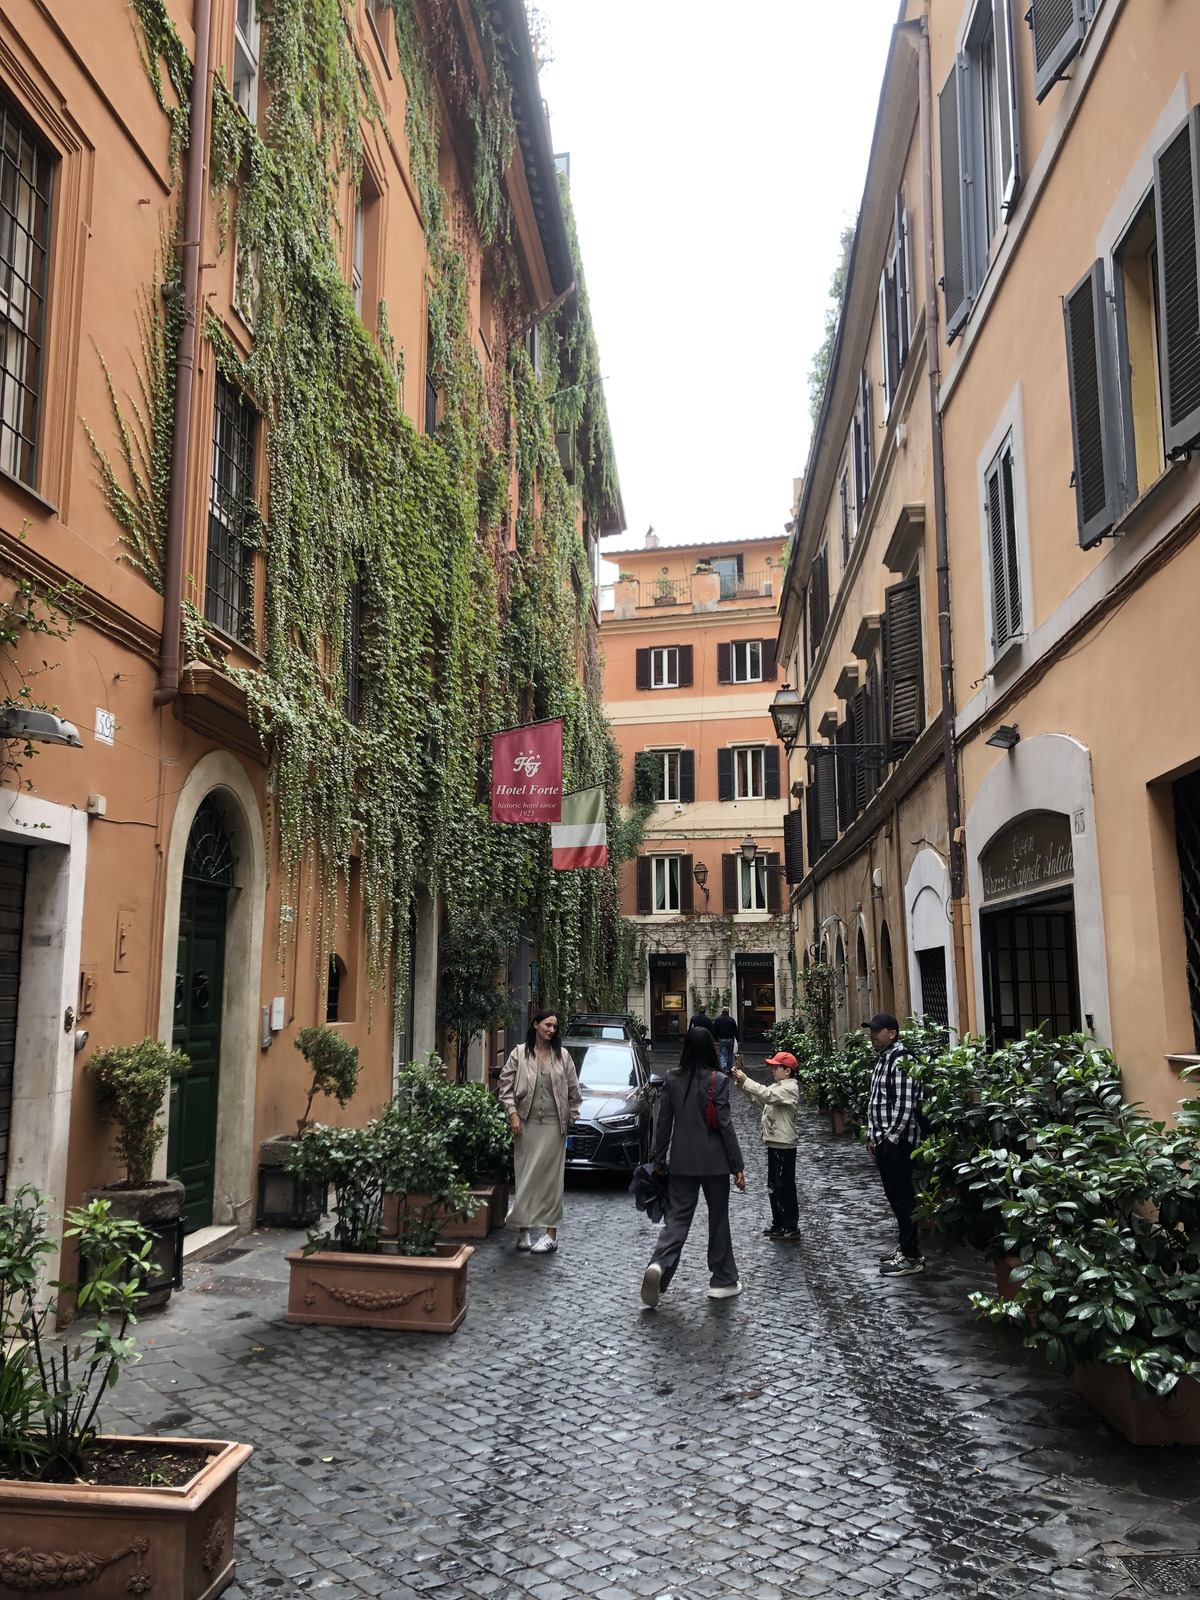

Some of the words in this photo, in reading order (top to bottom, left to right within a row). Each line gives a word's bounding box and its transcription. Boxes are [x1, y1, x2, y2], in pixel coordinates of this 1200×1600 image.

[496, 785, 526, 795] Hotel
[529, 785, 559, 795] Forte
[1043, 841, 1074, 878] Antich
